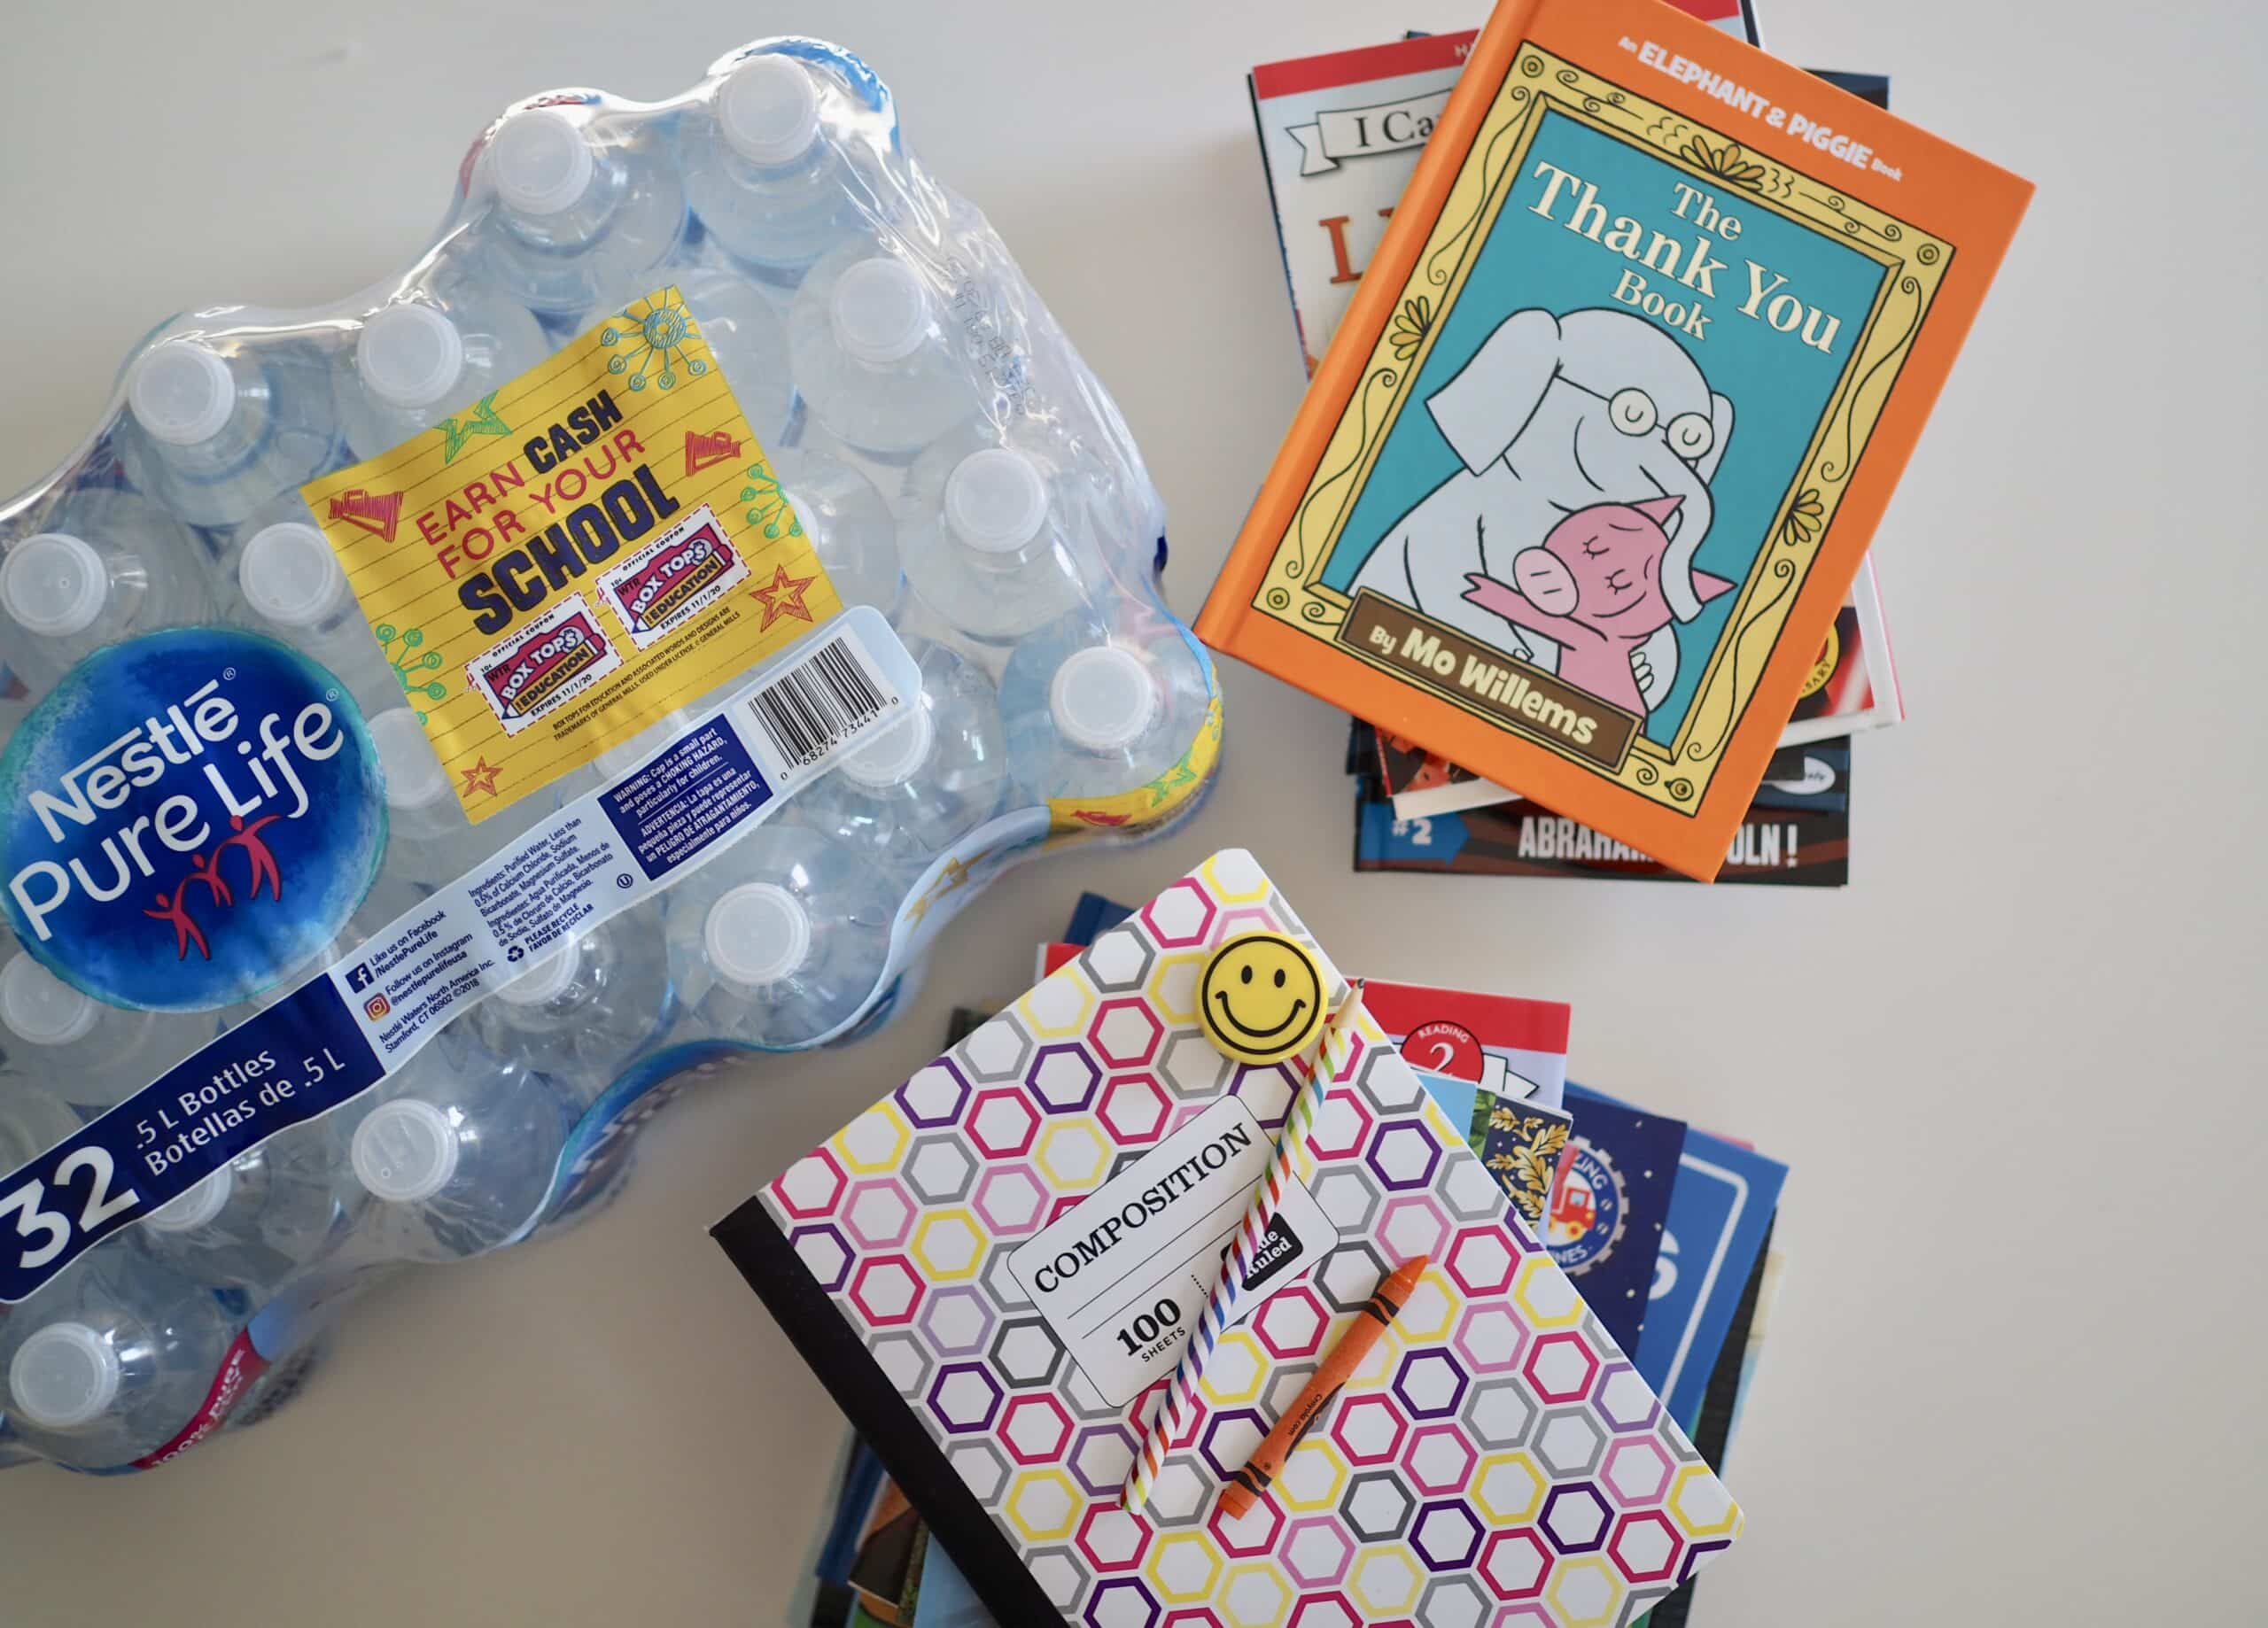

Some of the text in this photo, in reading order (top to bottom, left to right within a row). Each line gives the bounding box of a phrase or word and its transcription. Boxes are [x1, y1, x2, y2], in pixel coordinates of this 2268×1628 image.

[1354, 111, 1441, 148] I Ca
[1618, 36, 1903, 182] An ELEPHANT & PIGGIE Book
[1670, 182, 1743, 241] The
[1527, 161, 1728, 298] Thank
[1736, 259, 1841, 354] You
[1610, 268, 1712, 340] Book
[416, 390, 623, 547] EARN CASH
[438, 430, 645, 579] FOR YOUR
[457, 463, 680, 635] SCHOOL
[622, 527, 685, 570] OFFICIAL COUPON
[630, 542, 708, 614] BOX TOPS
[651, 562, 719, 620] EDUCATION
[660, 607, 690, 630] EXPIRES
[691, 585, 721, 609] 11/1/20
[492, 614, 555, 657] OFFICIAL COUPON
[501, 628, 579, 700] BOX TOPS
[522, 647, 589, 708] EDUCATION
[531, 693, 562, 717] EXPIRES
[562, 674, 592, 697] 11/1/20
[1370, 625, 1598, 744] By Mo Willems
[28, 679, 238, 843] Nestlé
[649, 764, 667, 779] Cap
[664, 758, 674, 767] is
[678, 739, 699, 757] small
[699, 729, 718, 745] part
[781, 696, 899, 780] 0 68274 73441 0
[618, 800, 634, 813] and
[633, 786, 656, 805] poses
[660, 757, 694, 784] CHOKING
[693, 736, 726, 762] HAZARD,
[635, 754, 721, 818] particularly for children.
[667, 817, 687, 833] pieza
[689, 798, 712, 818] puede
[711, 771, 753, 803] representar
[687, 794, 698, 804] La
[696, 784, 714, 800] tapa
[711, 777, 722, 787] es
[721, 768, 735, 780] una
[9, 702, 344, 942] Pure Life
[548, 827, 566, 841] Less
[564, 817, 581, 831] than
[656, 833, 685, 856] PELIGRO
[683, 826, 695, 836] DE
[665, 826, 715, 864] especialmente
[713, 817, 731, 831] para
[369, 911, 445, 966] Like us on Facebook
[524, 903, 579, 944] PLEASE RECYCLE
[528, 903, 594, 952] FAVOR DE RECICLAR
[385, 933, 472, 995] Follow us on Instagram
[400, 1003, 429, 1025] Waters
[426, 985, 449, 1004] North
[448, 965, 478, 989] America
[478, 957, 494, 971] Inc.
[417, 1013, 431, 1025] CT
[428, 996, 454, 1015] 06902
[1418, 1022, 1470, 1045] READING
[136, 1050, 276, 1149] .5 L Bottles
[144, 1049, 346, 1177] Botellas de .5 L
[0, 1146, 141, 1268] 32
[1035, 1122, 1252, 1293] COMPOSITION
[1116, 1299, 1181, 1357] 100
[1141, 1327, 1185, 1362] SHEETS
